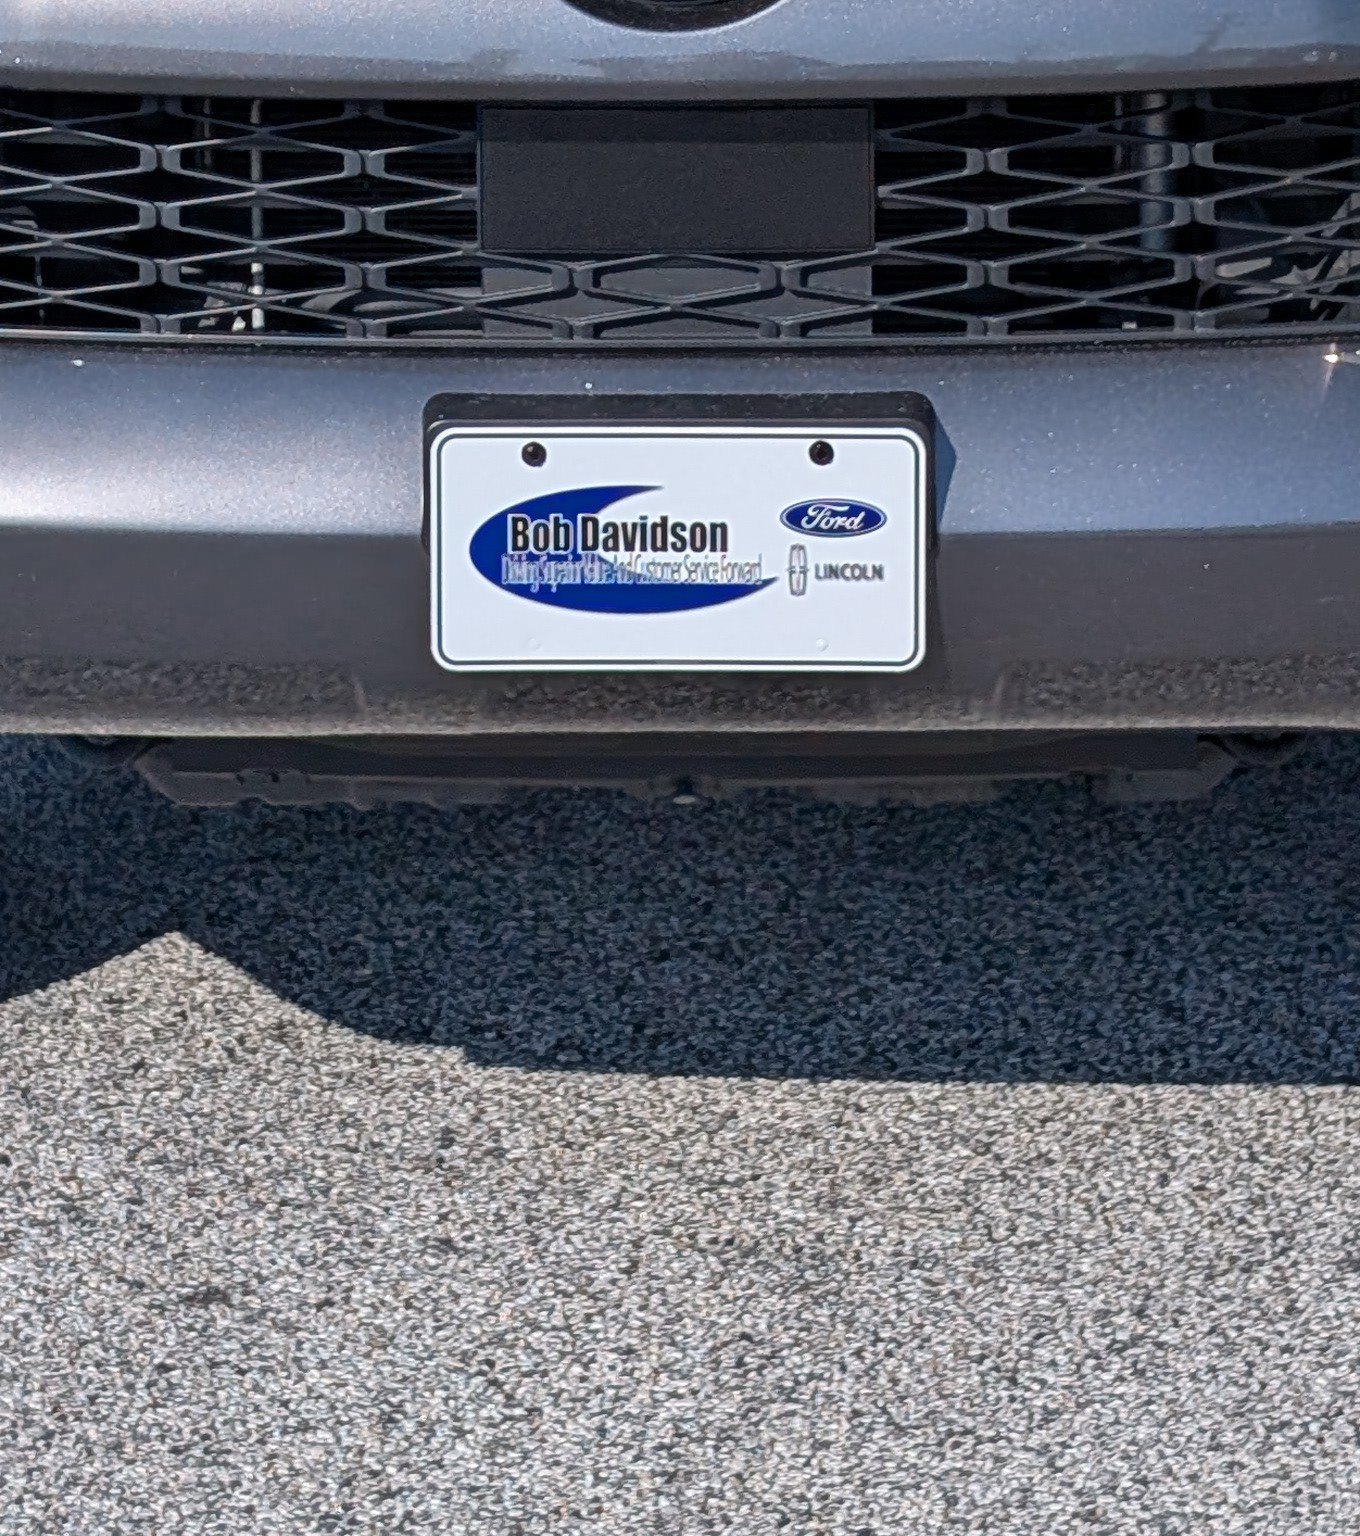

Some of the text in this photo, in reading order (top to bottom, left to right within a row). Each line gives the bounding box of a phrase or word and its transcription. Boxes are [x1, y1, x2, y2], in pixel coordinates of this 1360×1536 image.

[800, 503, 866, 531] Ford
[510, 515, 729, 553] Bob Davidson
[683, 553, 719, 584] Service
[720, 553, 763, 584] Forward
[814, 562, 885, 581] LINCOLN
